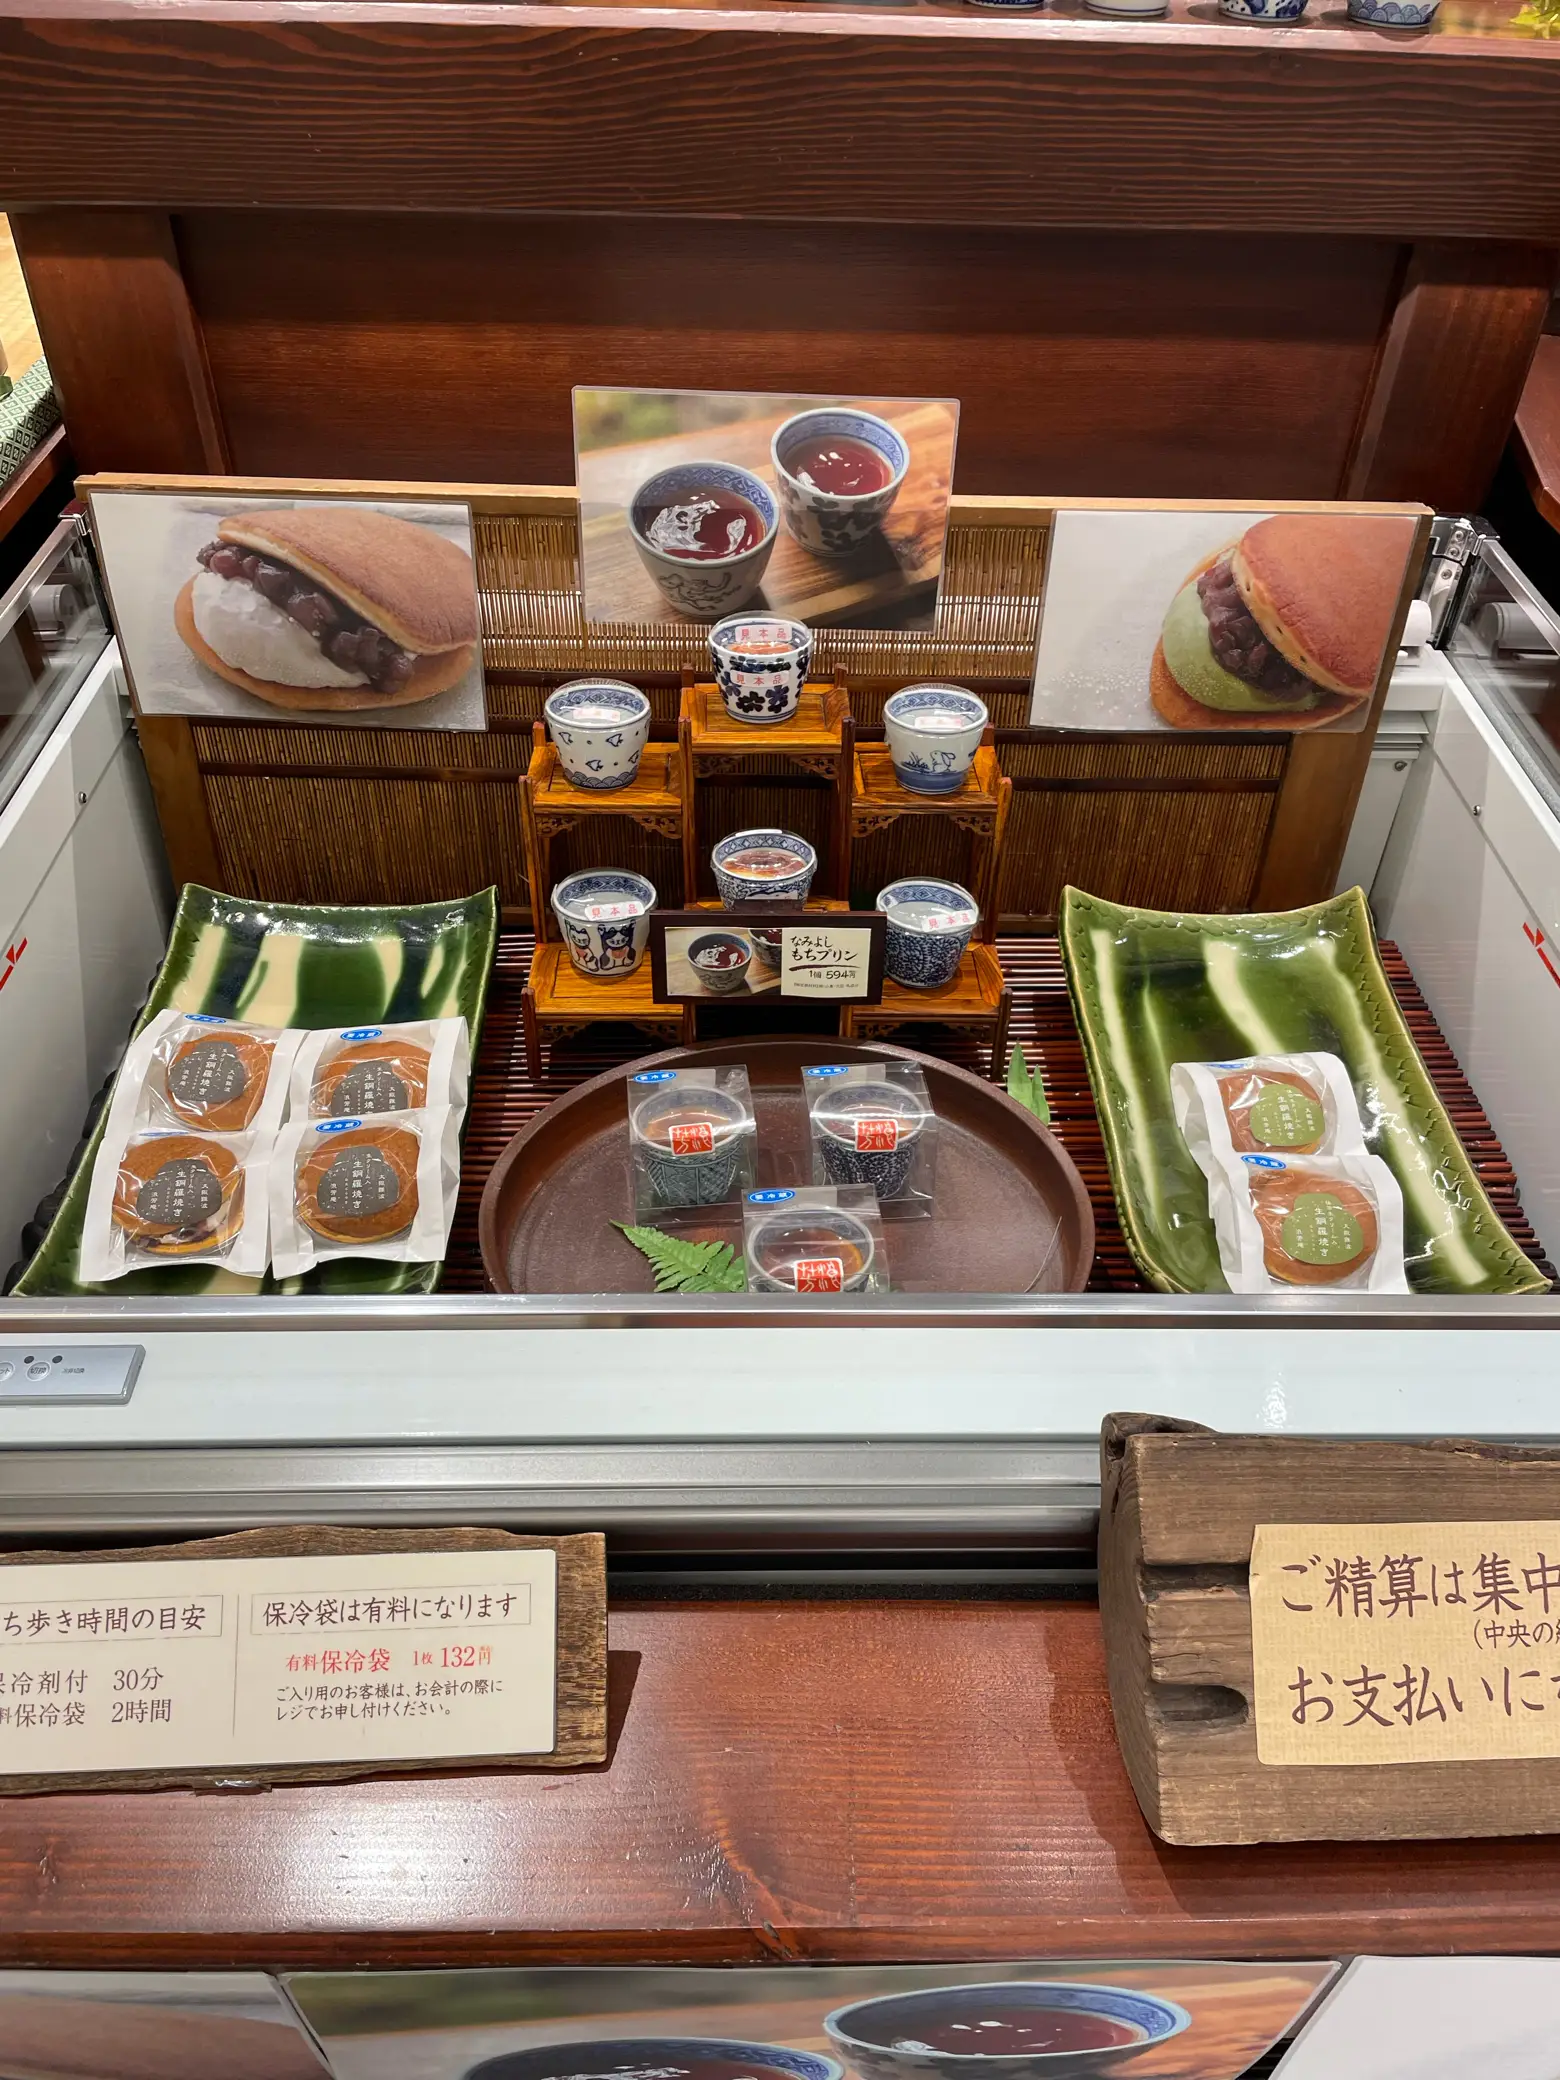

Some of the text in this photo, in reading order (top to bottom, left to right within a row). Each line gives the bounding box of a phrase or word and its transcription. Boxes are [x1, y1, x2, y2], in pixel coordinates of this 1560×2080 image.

[740, 627, 787, 641] 見本品
[736, 673, 782, 686] 見本品
[591, 903, 639, 919] 見本品
[790, 935, 834, 948] なみよし
[791, 948, 859, 962] もちプリン
[1281, 1552, 1560, 1618] ご精算は集中
[3, 1603, 207, 1638] ち歩き時間の目安
[263, 1592, 518, 1628] 保冷袋は有料になります
[1473, 1618, 1560, 1650] (中央の
[285, 1647, 391, 1675] 有料保冷袋
[413, 1650, 433, 1666] 1枚
[0, 1666, 165, 1697] 冷剤付 30分
[276, 1678, 503, 1703] ご入り用のお客様は、お会計の際に
[111, 1698, 173, 1724] 2時間
[276, 1700, 452, 1721] レジでお申し付けください。
